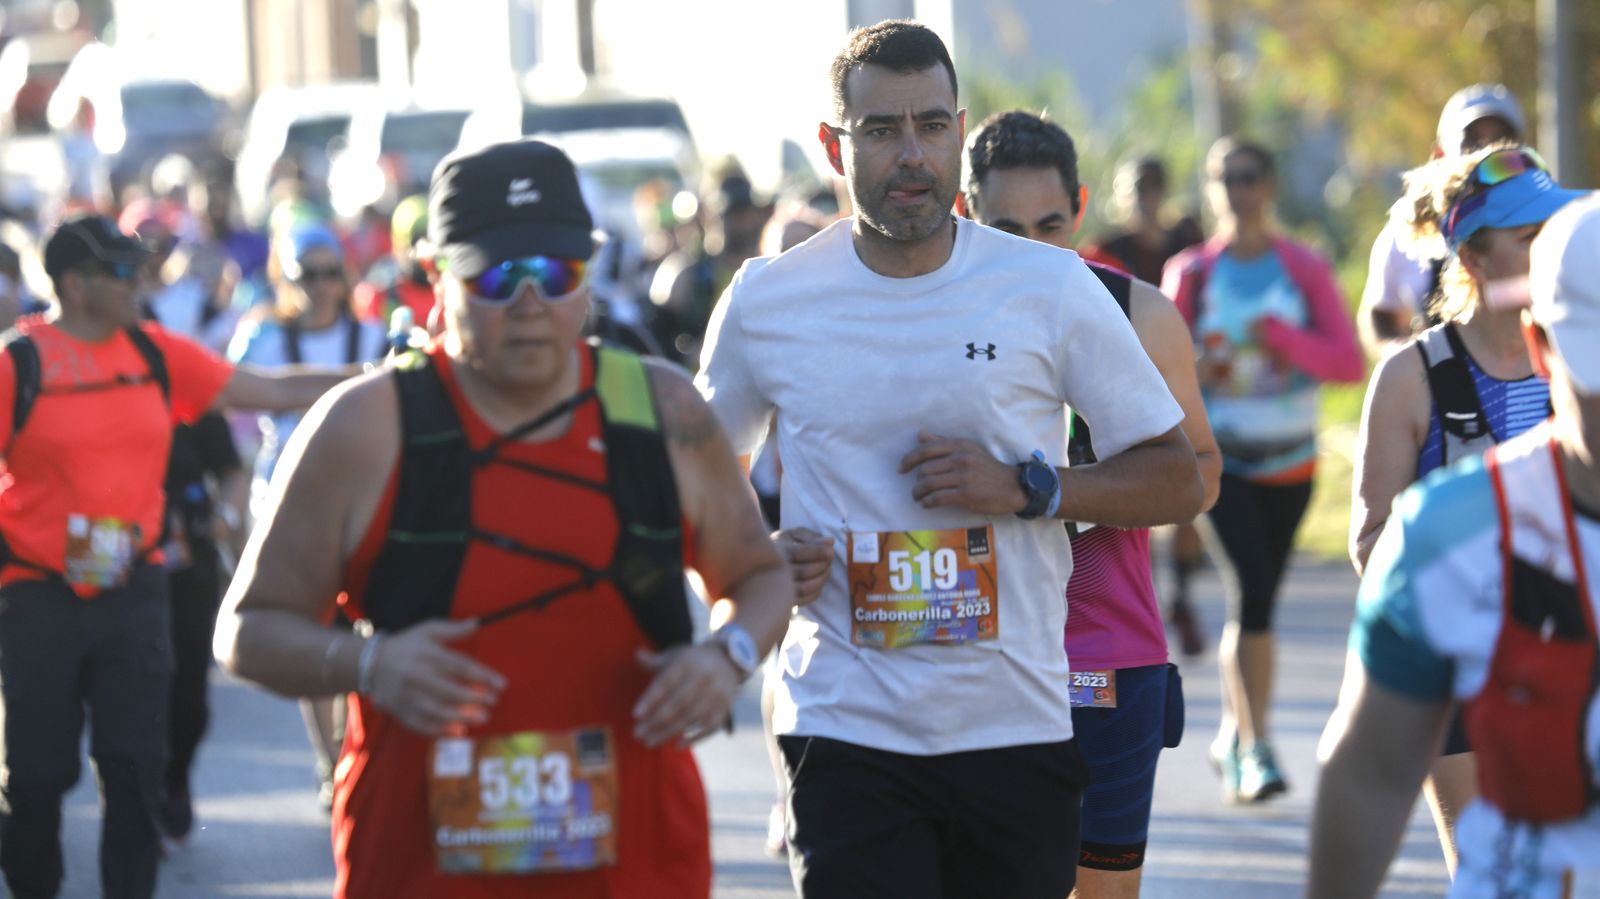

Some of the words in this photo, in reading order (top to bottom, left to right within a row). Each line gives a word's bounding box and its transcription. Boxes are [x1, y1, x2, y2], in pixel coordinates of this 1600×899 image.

[888, 547, 958, 592] 519
[855, 605, 952, 621] Carbonerilla
[956, 602, 991, 618] 2023
[1073, 675, 1108, 687] 2023
[478, 751, 571, 809] 533
